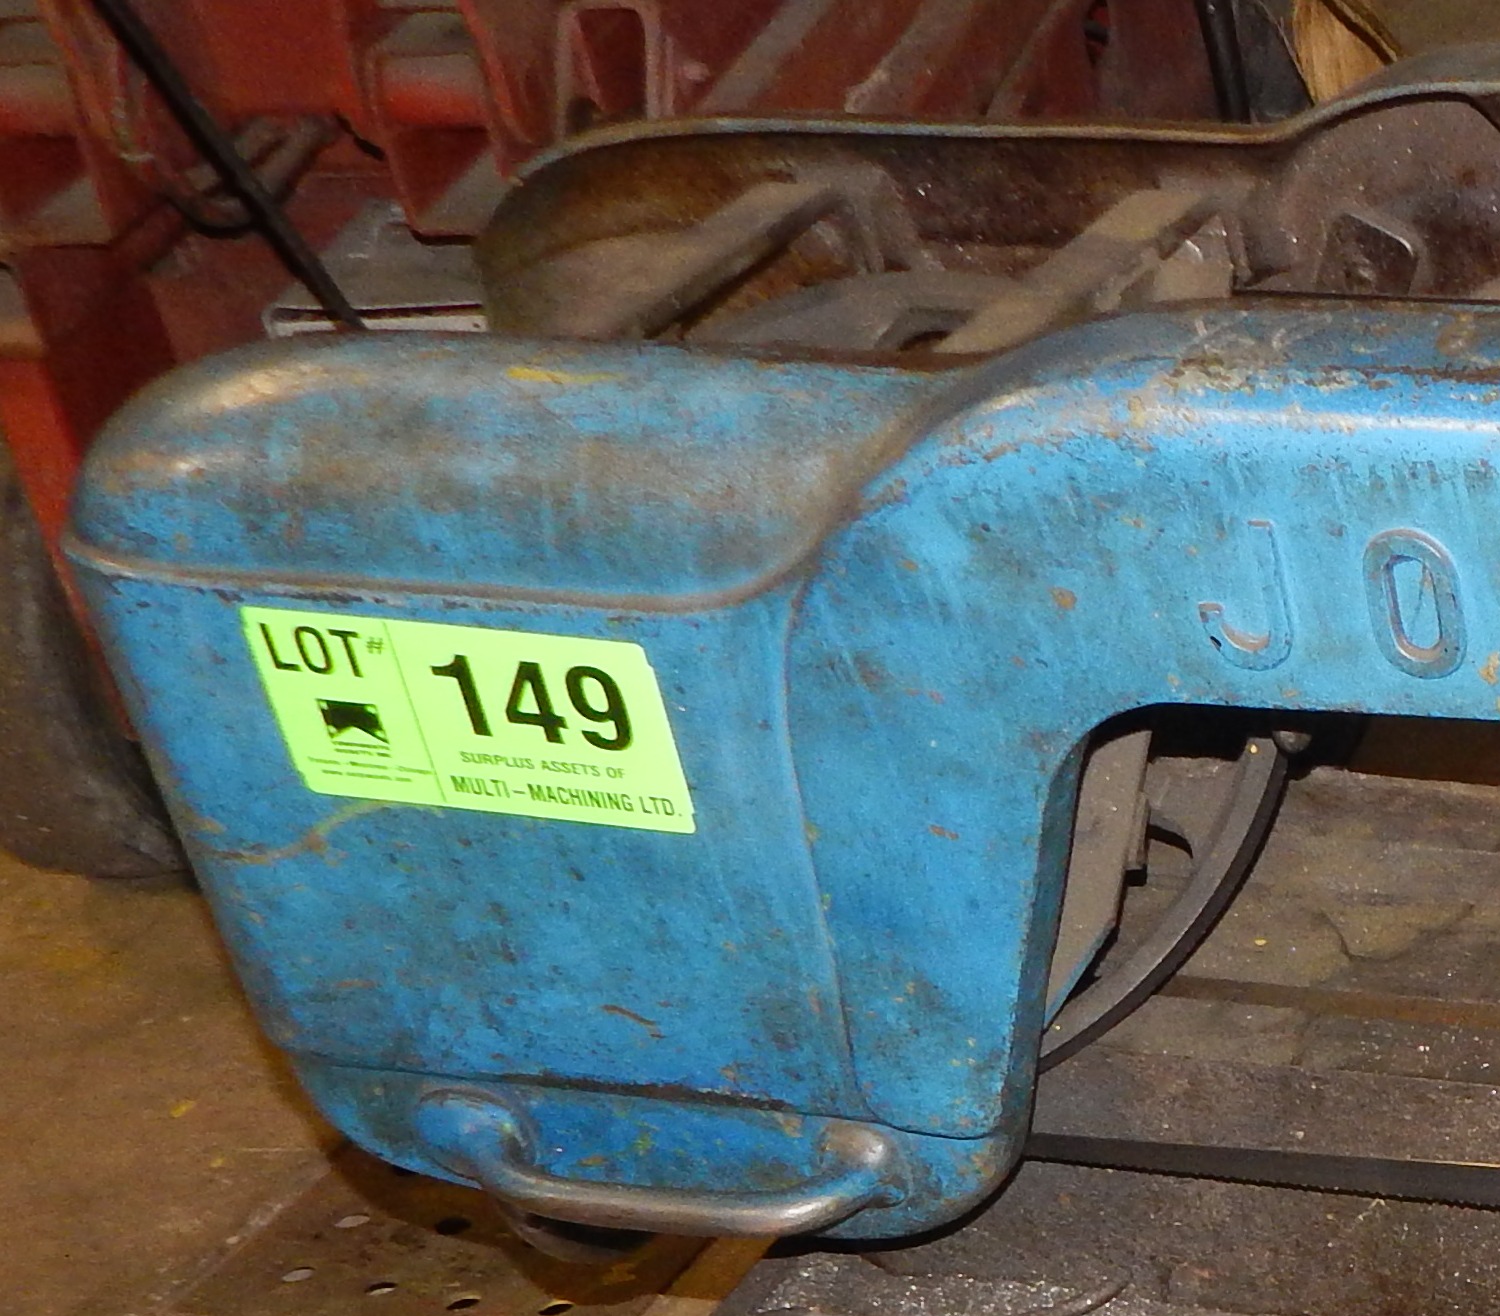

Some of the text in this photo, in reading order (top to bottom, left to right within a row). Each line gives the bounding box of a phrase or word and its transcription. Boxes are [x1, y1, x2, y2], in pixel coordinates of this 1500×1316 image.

[431, 653, 634, 752] 149
[459, 750, 626, 779] SURPLUS ASSETS OF
[638, 795, 684, 818] LTD.
